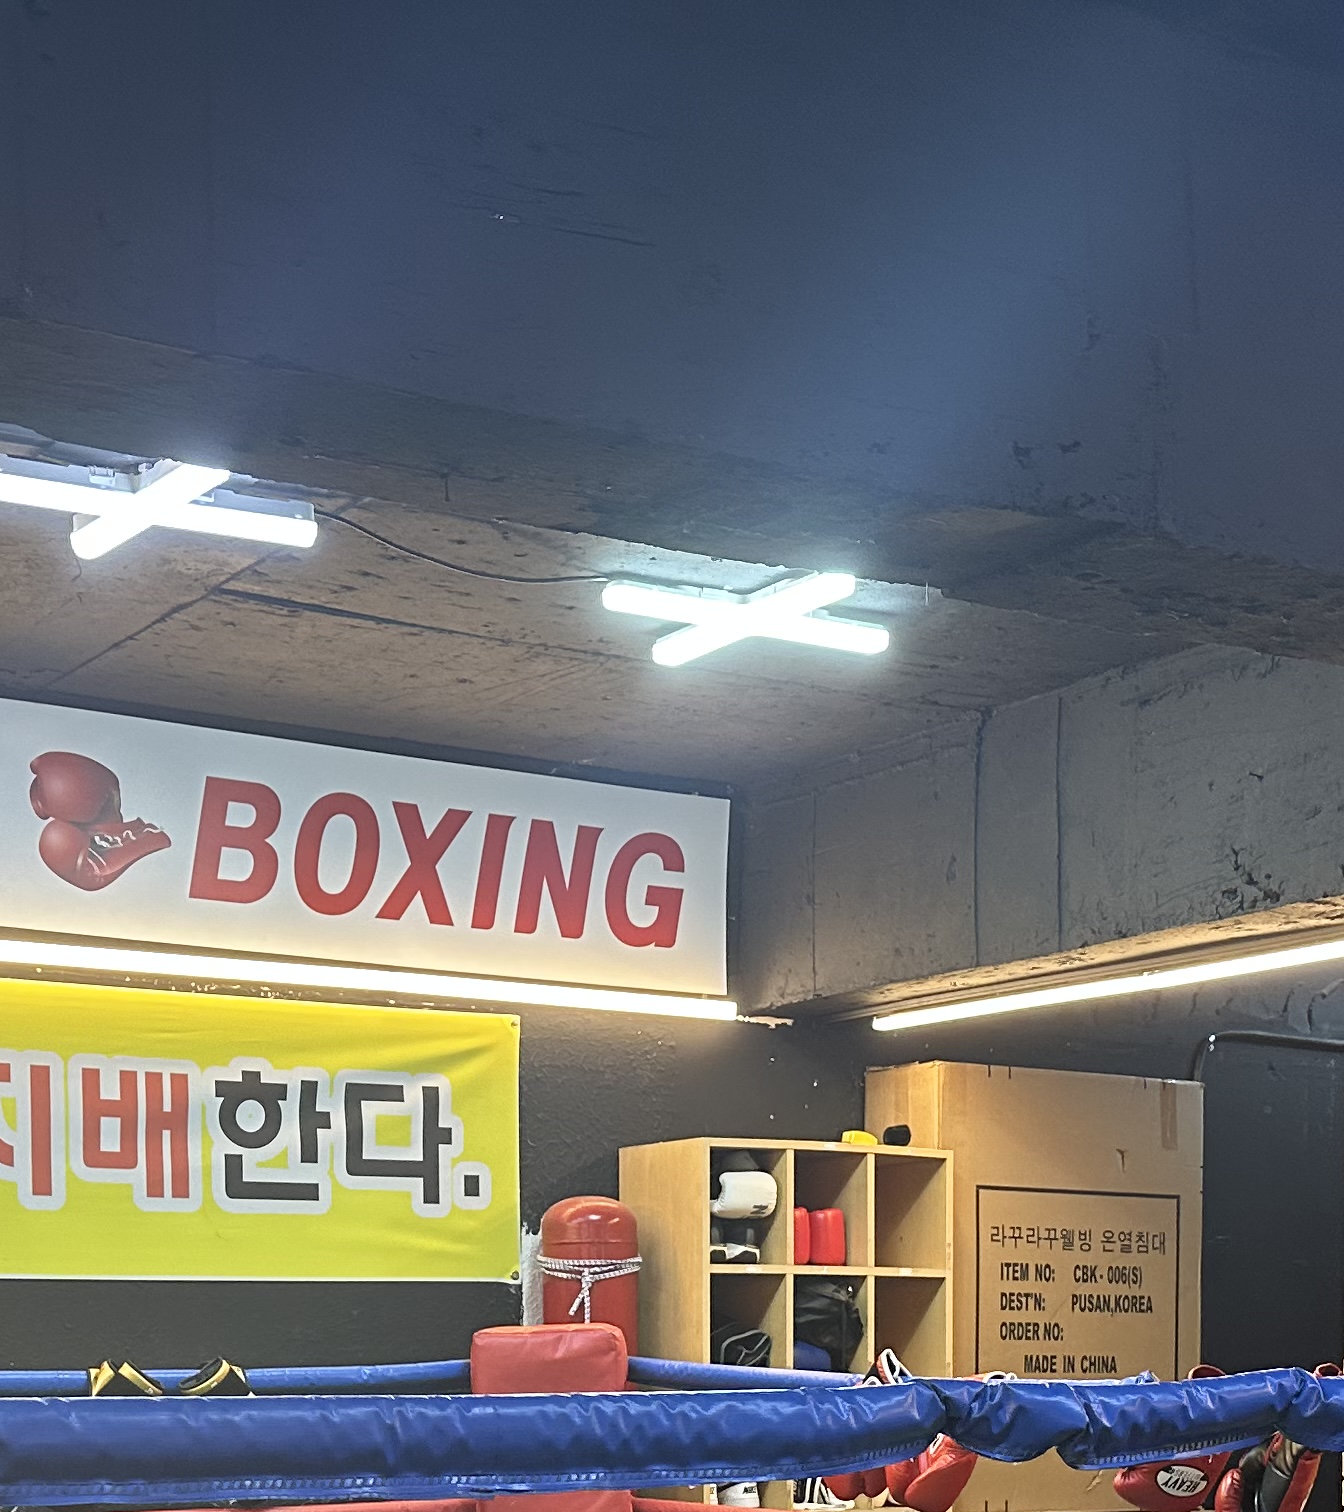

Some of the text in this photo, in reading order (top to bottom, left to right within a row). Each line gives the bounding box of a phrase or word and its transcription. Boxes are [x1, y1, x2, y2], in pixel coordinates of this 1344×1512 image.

[188, 775, 686, 949] BOXING
[989, 1223, 1167, 1256] 라꾸라꾸웰빙 온열침대
[1000, 1261, 1030, 1282] ITEM
[1034, 1262, 1056, 1283] NO:
[999, 1321, 1064, 1342] ORDER NO:
[1023, 1354, 1118, 1374] MADE IN CHINA
[1161, 1475, 1201, 1493] HEAVY
